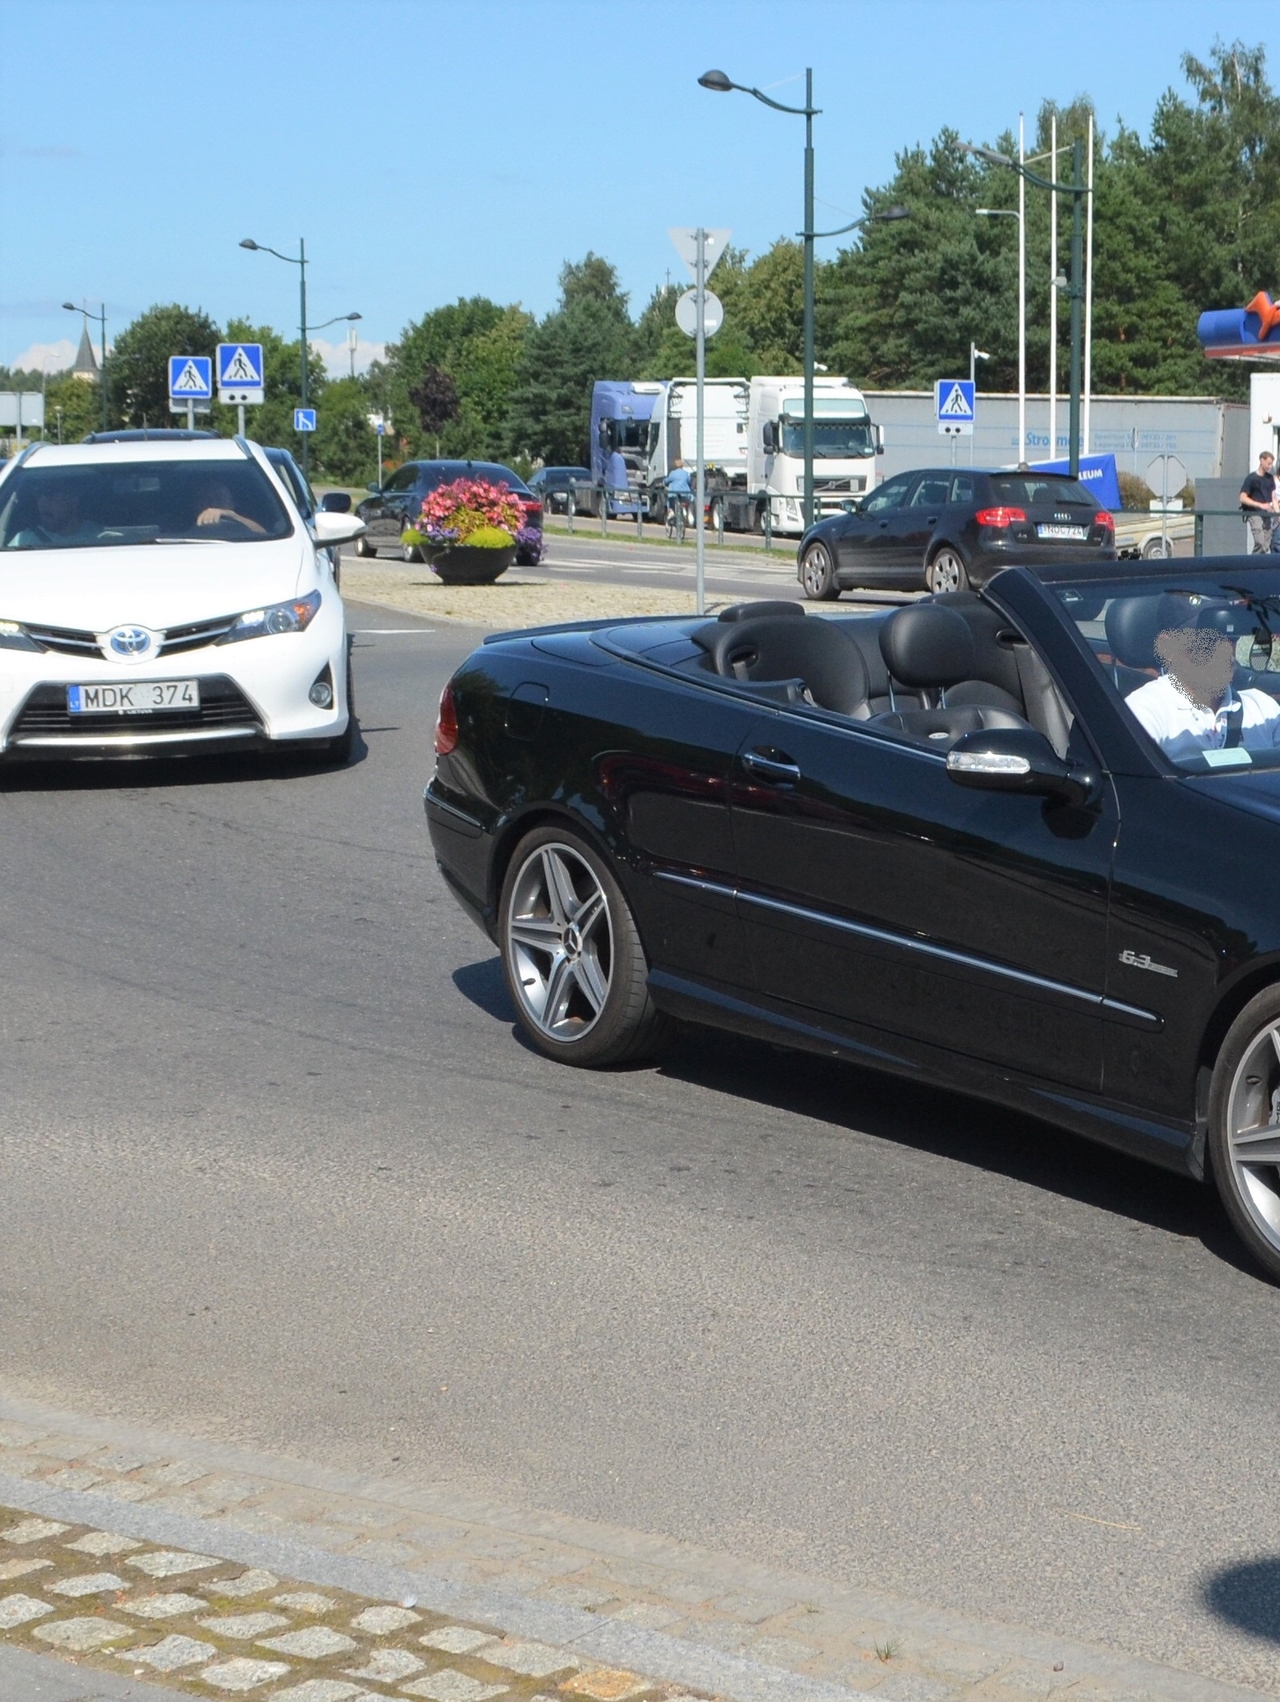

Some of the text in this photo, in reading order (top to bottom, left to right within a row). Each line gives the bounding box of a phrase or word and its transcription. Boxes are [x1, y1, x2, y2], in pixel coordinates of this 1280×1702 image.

[1078, 468, 1103, 480] LEUM
[84, 684, 193, 708] MDK 374
